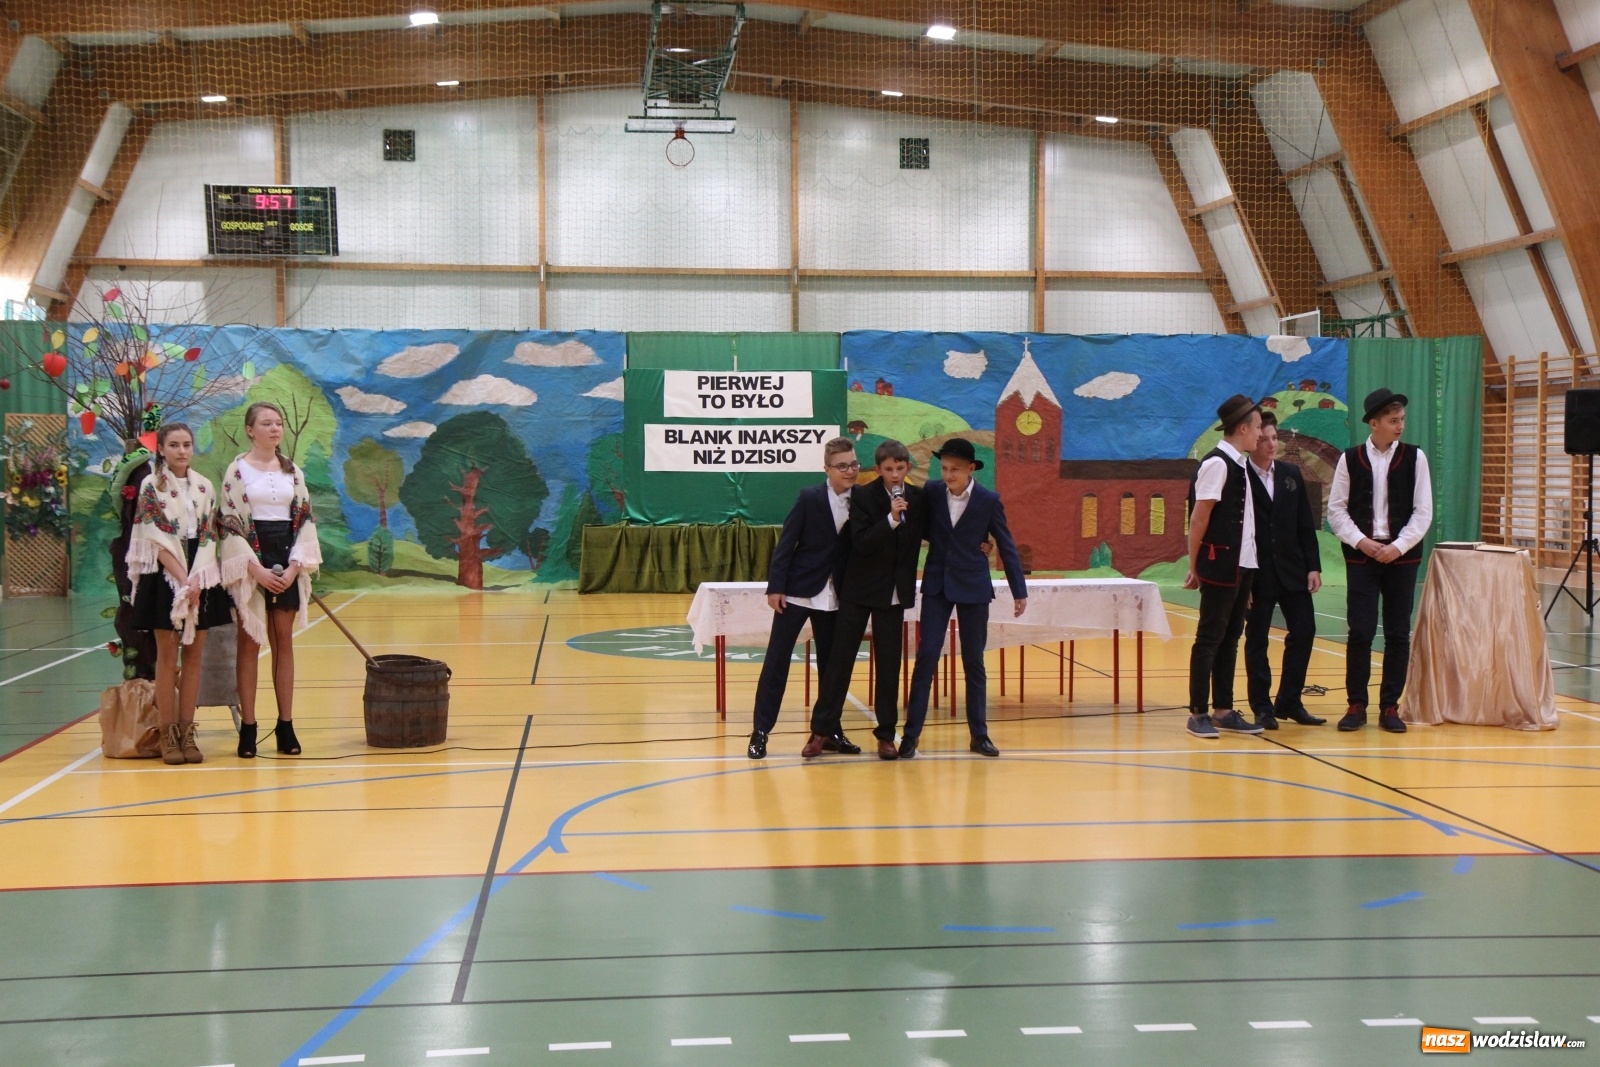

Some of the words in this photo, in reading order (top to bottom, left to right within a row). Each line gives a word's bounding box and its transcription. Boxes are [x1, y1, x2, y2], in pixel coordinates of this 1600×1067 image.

[255, 194, 293, 210] 9:57
[221, 221, 264, 231] GOSPODARZE
[289, 221, 314, 232] GOŚCIE
[697, 375, 784, 391] PIERWEJ
[698, 394, 725, 409] TO
[731, 393, 784, 409] BYŁO
[664, 429, 732, 445] BLANK
[738, 429, 826, 445] INAKSZY
[693, 446, 726, 465] NIŻ
[731, 448, 797, 465] DZISIO
